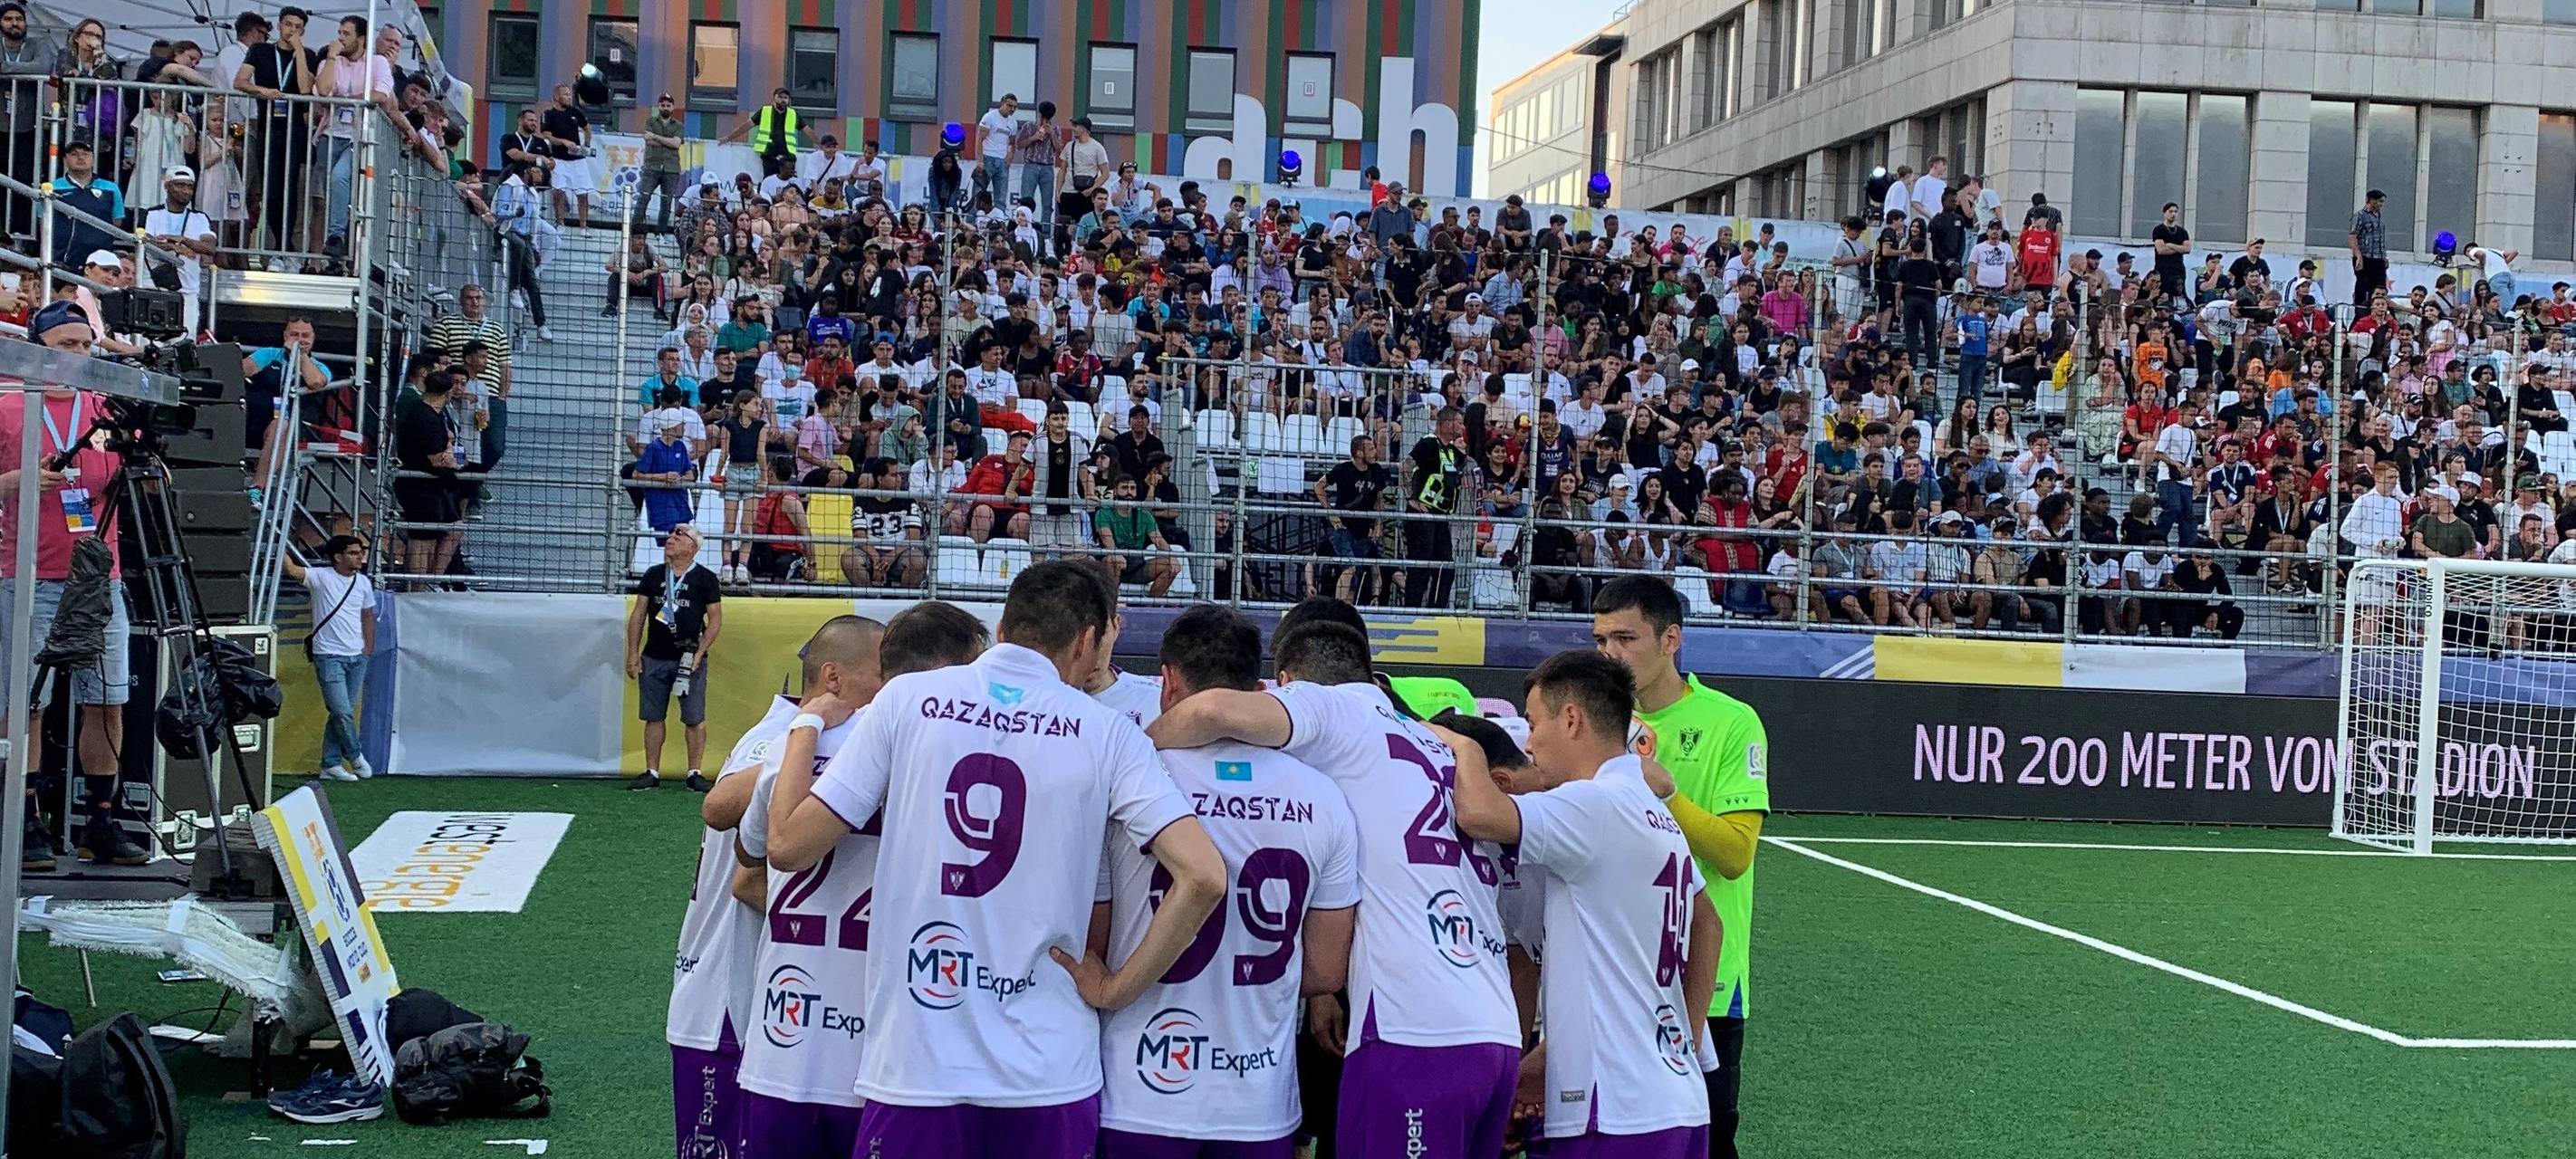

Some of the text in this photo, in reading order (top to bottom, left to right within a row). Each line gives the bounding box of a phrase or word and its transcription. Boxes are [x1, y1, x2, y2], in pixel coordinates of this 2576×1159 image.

[870, 514, 902, 537] 23
[921, 696, 1081, 738] QAZAQSTAN
[1914, 724, 2535, 799] NUR 200 METER VOM STDION
[942, 752, 1026, 898] 9
[1192, 792, 1313, 823] ZAQSTAN
[360, 814, 516, 908] westenergie
[908, 948, 973, 987] MRT
[764, 988, 865, 1039] MRT Exp
[1136, 1033, 1277, 1078] MRT Expert
[692, 1066, 718, 1159] RT Expert
[1405, 1107, 1427, 1159] xpert
